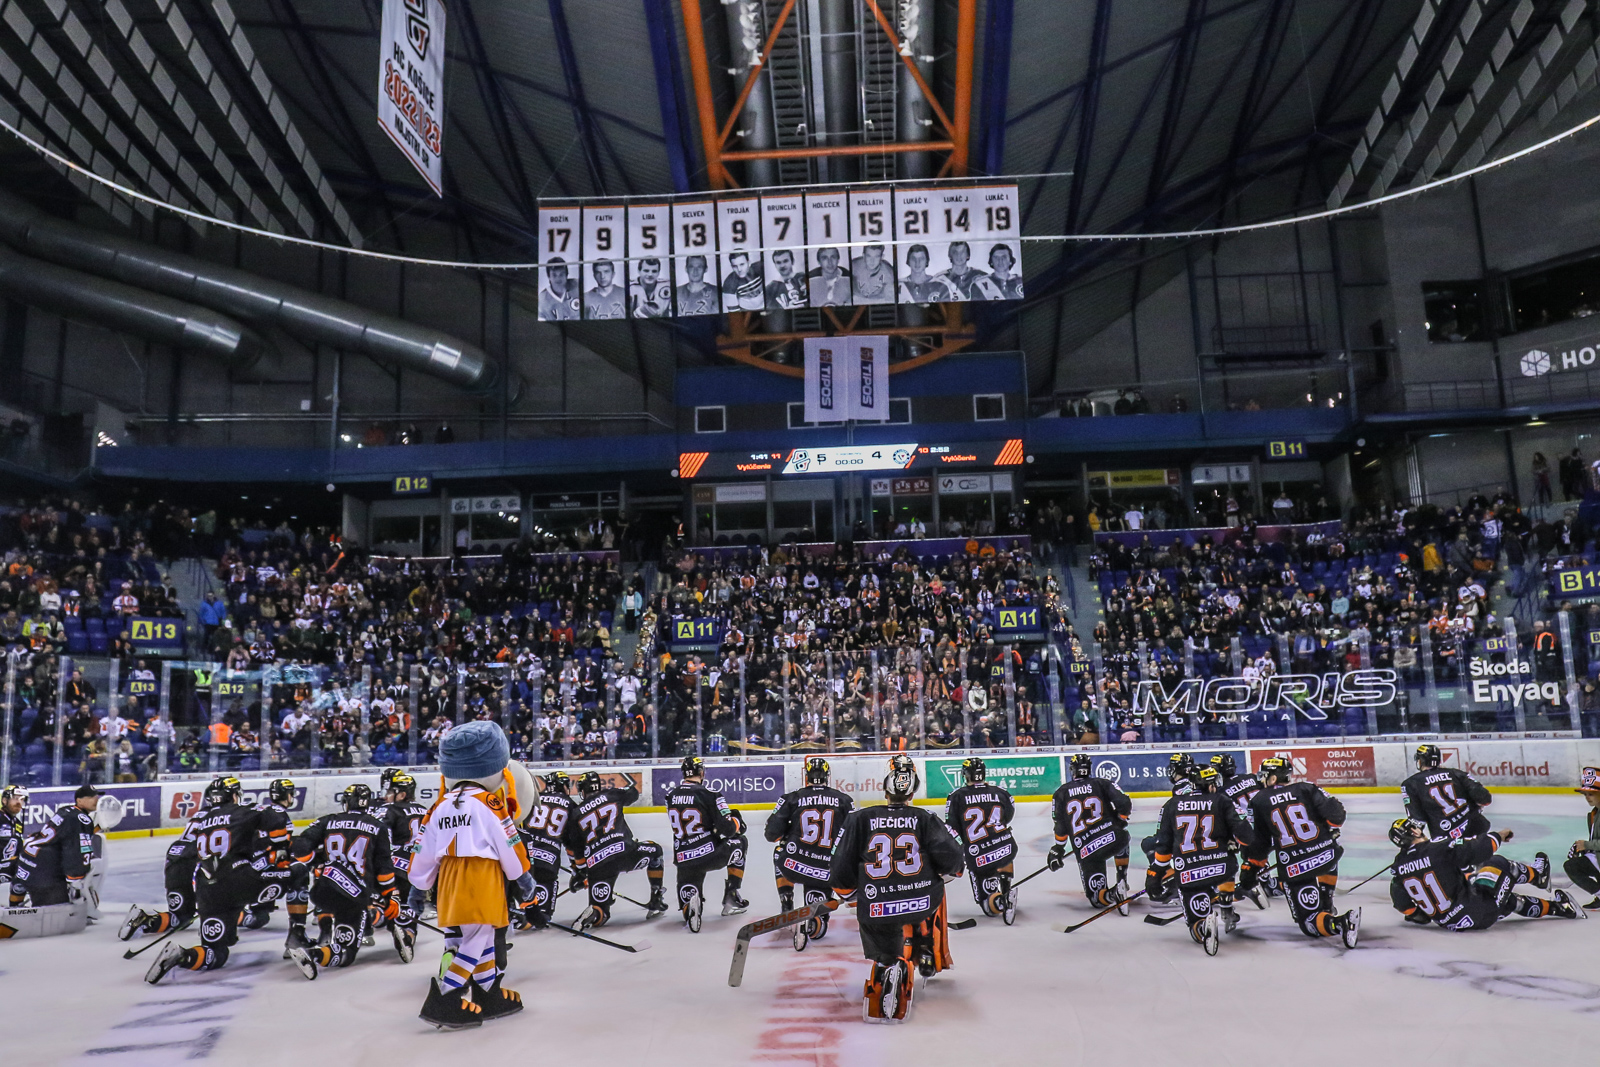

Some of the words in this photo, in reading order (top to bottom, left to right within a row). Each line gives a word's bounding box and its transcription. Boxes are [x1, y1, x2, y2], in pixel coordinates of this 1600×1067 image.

[394, 41, 405, 70] HC
[407, 60, 434, 111] KOŠICE
[384, 59, 441, 157] 2022/23
[394, 113, 421, 156] MAJSTRI
[422, 147, 430, 169] SR
[726, 206, 750, 214] TROJÁK
[767, 203, 797, 212] BRUNCLÍK
[812, 201, 840, 209] HOLEČEK
[858, 198, 884, 206] KOLLÁTH
[550, 214, 568, 222] BOŽÍK
[822, 214, 832, 238] 1
[859, 210, 883, 236] 15
[904, 210, 930, 234] 21
[944, 208, 970, 233] 14
[985, 206, 1011, 232] 19
[682, 222, 707, 248] 13
[732, 219, 748, 244] 9
[774, 216, 791, 242] 7
[548, 228, 572, 252] 17
[596, 227, 612, 251] 9
[641, 226, 657, 250] 5
[821, 365, 833, 409] TIPOS
[862, 363, 874, 408] TIPOS
[872, 451, 882, 459] 4
[736, 463, 772, 472] Vylúčenie
[412, 477, 428, 489] 12
[1020, 611, 1036, 626] 11
[154, 622, 176, 640] 13
[696, 622, 714, 637] 11
[1470, 656, 1530, 676] Škoda
[141, 682, 154, 692] 13
[231, 684, 244, 694] 12
[1133, 670, 1396, 720] MORIS
[1472, 680, 1560, 707] Enyaq
[984, 766, 1046, 778] ERMOSTAV
[1100, 764, 1118, 780] USS
[1322, 760, 1364, 768] VÝKOVKY
[1465, 760, 1550, 776] Kaufland
[1322, 770, 1366, 778] ODLIATKY
[700, 776, 776, 793] ROMISEO
[835, 779, 884, 792] Kaufla
[1068, 784, 1093, 797] MIKÚŠ
[1225, 778, 1257, 797] BELUŠKO
[540, 796, 570, 808] FERENC
[580, 794, 608, 814] ROGOŇ
[672, 794, 694, 806] ŠIMUN
[965, 794, 1000, 804] HAVRILA
[1178, 800, 1213, 812] ŠEDIVÝ
[1270, 792, 1297, 806] DEYL
[201, 814, 231, 830] LLOCK
[527, 804, 569, 838] 89
[578, 802, 618, 844] 77
[668, 808, 704, 840] 92
[870, 816, 918, 831] RIEČICKÝ
[1066, 796, 1104, 836] 23
[800, 808, 834, 848] 61
[964, 806, 1007, 844] 24
[1270, 802, 1320, 848] 18
[1088, 833, 1114, 851] TIPOS
[1176, 814, 1219, 854] 71
[325, 832, 370, 876] 84
[532, 850, 555, 862] IPOS
[595, 844, 622, 862] TIPOS
[686, 844, 713, 859] TIPOS
[864, 832, 924, 880] 33
[988, 846, 1010, 860] TIPOS
[1300, 850, 1333, 872] TIPOS
[1398, 856, 1432, 876] CHOVAN
[798, 864, 829, 880] TIPOS
[1191, 864, 1225, 878] TIPOS
[332, 869, 362, 896] TIPOS
[898, 882, 914, 891] Steel
[914, 880, 932, 889] Košice
[1092, 878, 1105, 888] USS
[594, 888, 608, 898] USS
[682, 888, 696, 900] USS
[1300, 890, 1318, 904] USS
[1404, 870, 1452, 916] 91
[886, 898, 928, 914] TIPOS
[1194, 900, 1210, 912] USS
[204, 923, 222, 936] USS
[336, 929, 352, 944] USS
